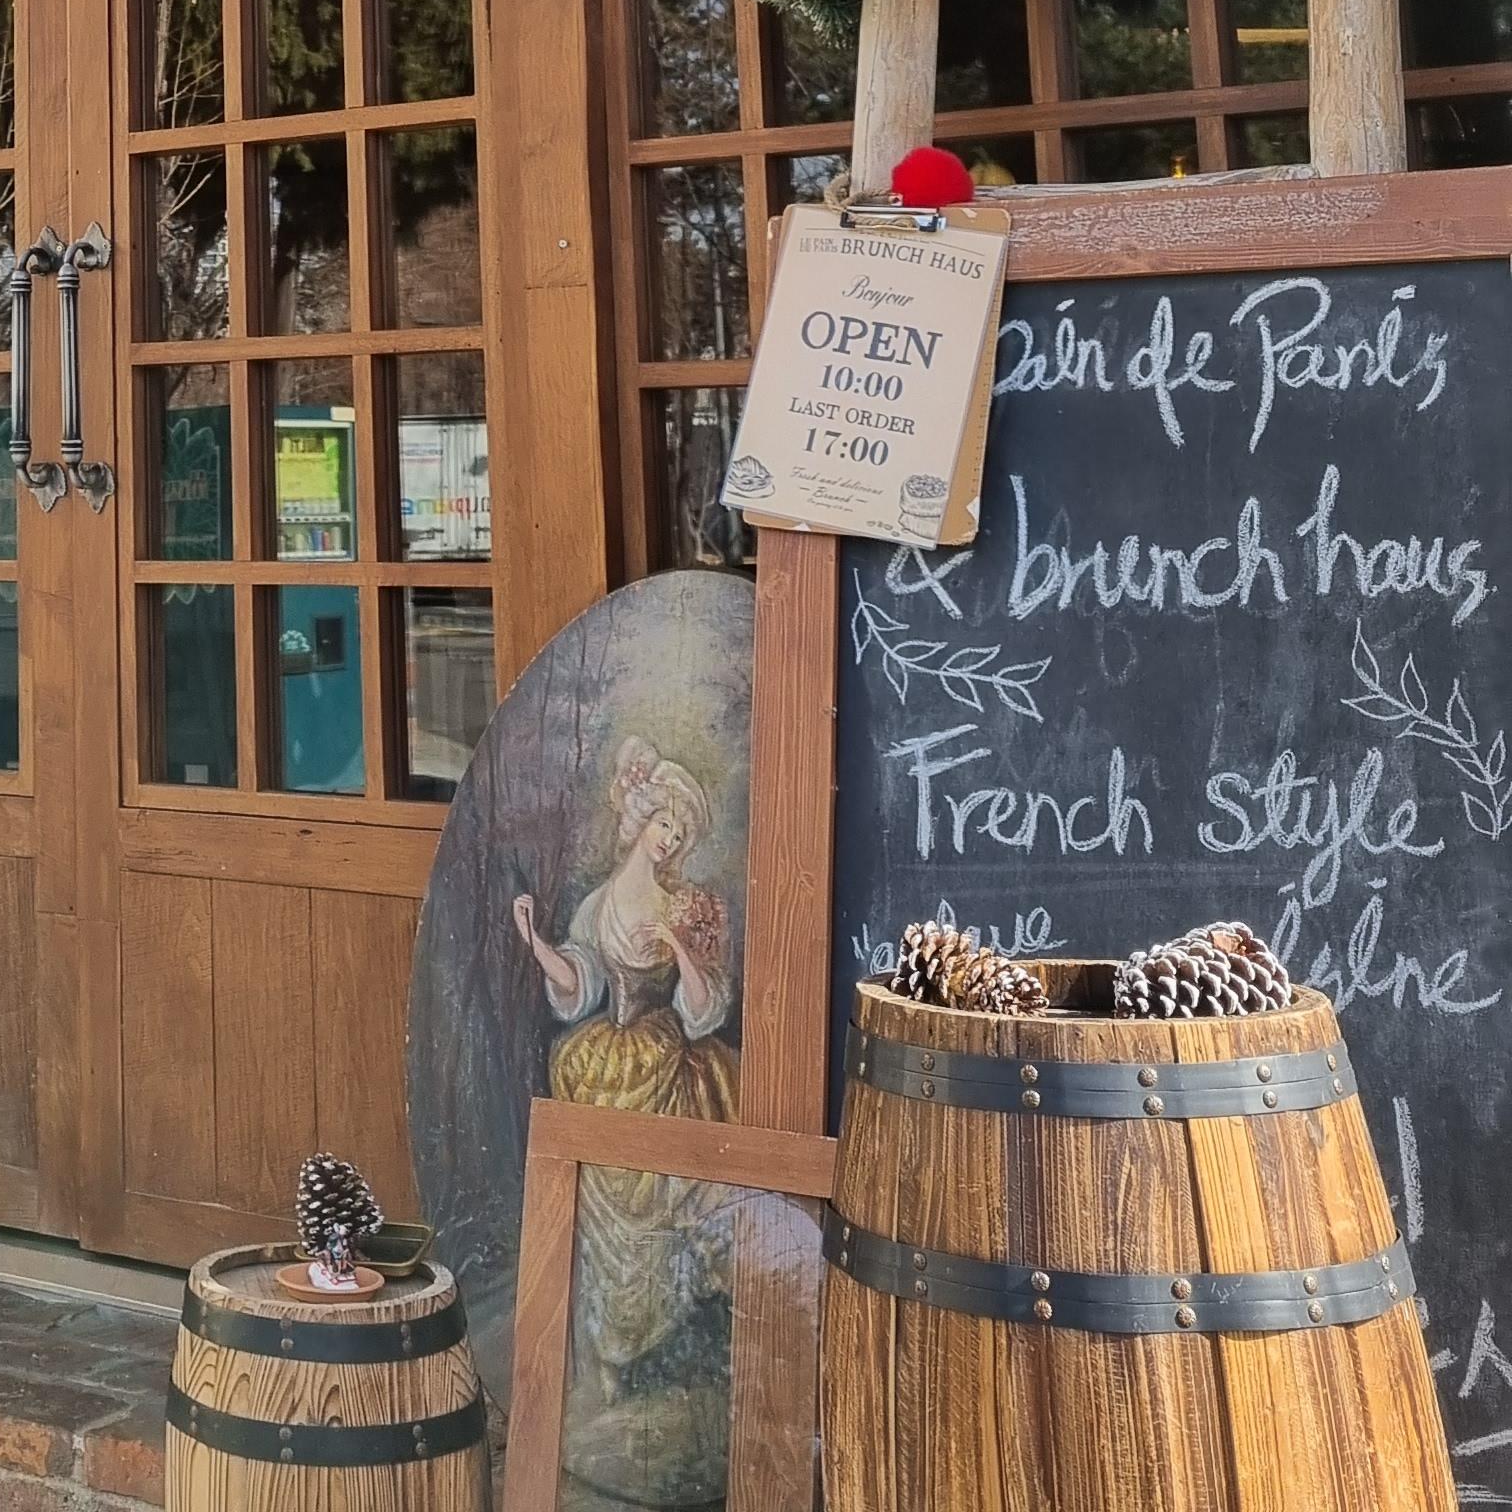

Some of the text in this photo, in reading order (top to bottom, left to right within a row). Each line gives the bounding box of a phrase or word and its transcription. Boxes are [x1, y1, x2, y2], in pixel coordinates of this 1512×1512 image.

[840, 238, 985, 280] BRUNCH HAUS
[842, 274, 915, 309] Bonjour
[801, 311, 943, 370] OPEN
[820, 364, 903, 402] 10:00
[1125, 295, 1237, 449] de
[1229, 276, 1448, 454] Paris
[788, 397, 915, 436] LAST ORDER
[803, 427, 889, 467] 17:00
[1007, 474, 1290, 620] brunch
[884, 724, 1155, 861] French
